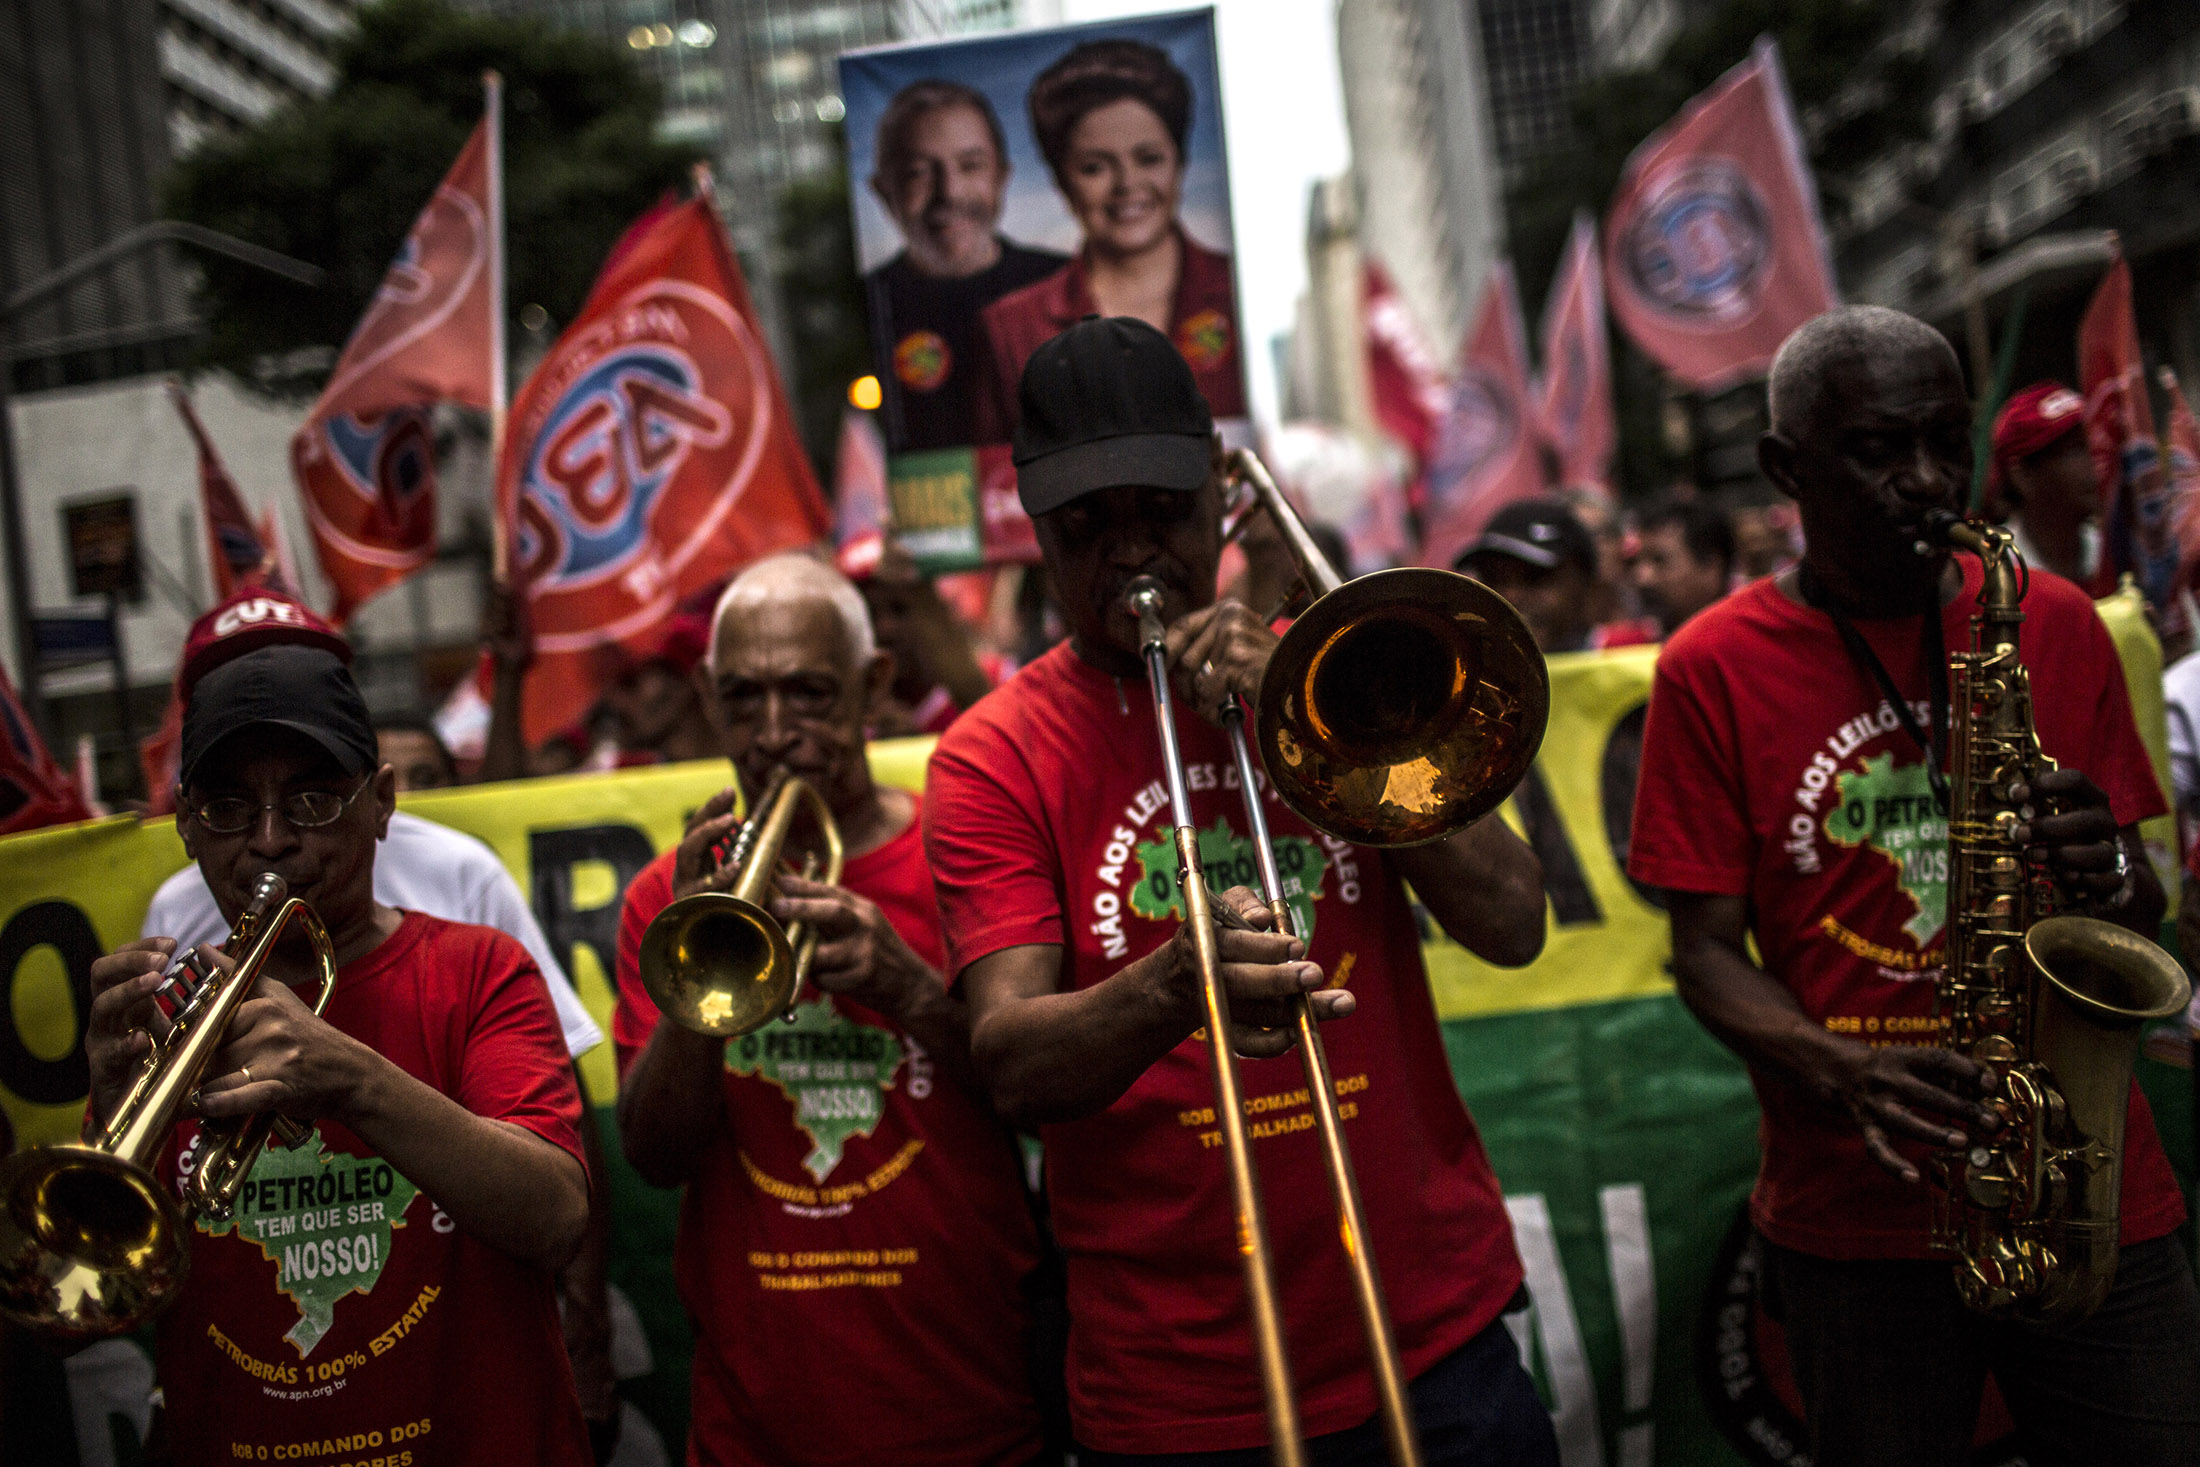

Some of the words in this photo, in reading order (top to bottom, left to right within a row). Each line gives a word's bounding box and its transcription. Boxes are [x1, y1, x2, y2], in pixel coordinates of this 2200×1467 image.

[213, 597, 308, 637] CUT
[1794, 750, 1839, 814] AOS
[1826, 699, 1932, 760] LEILÕS
[1123, 763, 1219, 828] LEILES
[1848, 798, 1866, 829] O
[1920, 821, 1949, 842] QU
[1096, 823, 1138, 887] AOS
[1151, 869, 1171, 901] O
[1090, 890, 1129, 960] NÃO
[1825, 1016, 1862, 1034] SOB
[1864, 1016, 1881, 1034] O
[1243, 1088, 1312, 1116] COMAN
[242, 1163, 394, 1215] PETRÓLEO
[254, 1217, 297, 1240] TEM
[301, 1207, 342, 1231] QUE
[346, 1201, 386, 1225] SER
[284, 1232, 381, 1284] NOSSO!
[206, 1322, 299, 1385] PETROBRÁS
[304, 1350, 368, 1384] 100%
[367, 1284, 442, 1358] ESTATAL
[262, 1377, 348, 1402] www.apn.org.br
[231, 1441, 254, 1461] SOB
[256, 1444, 269, 1461] O
[272, 1430, 385, 1461] COMANDO
[390, 1417, 432, 1444] DOS
